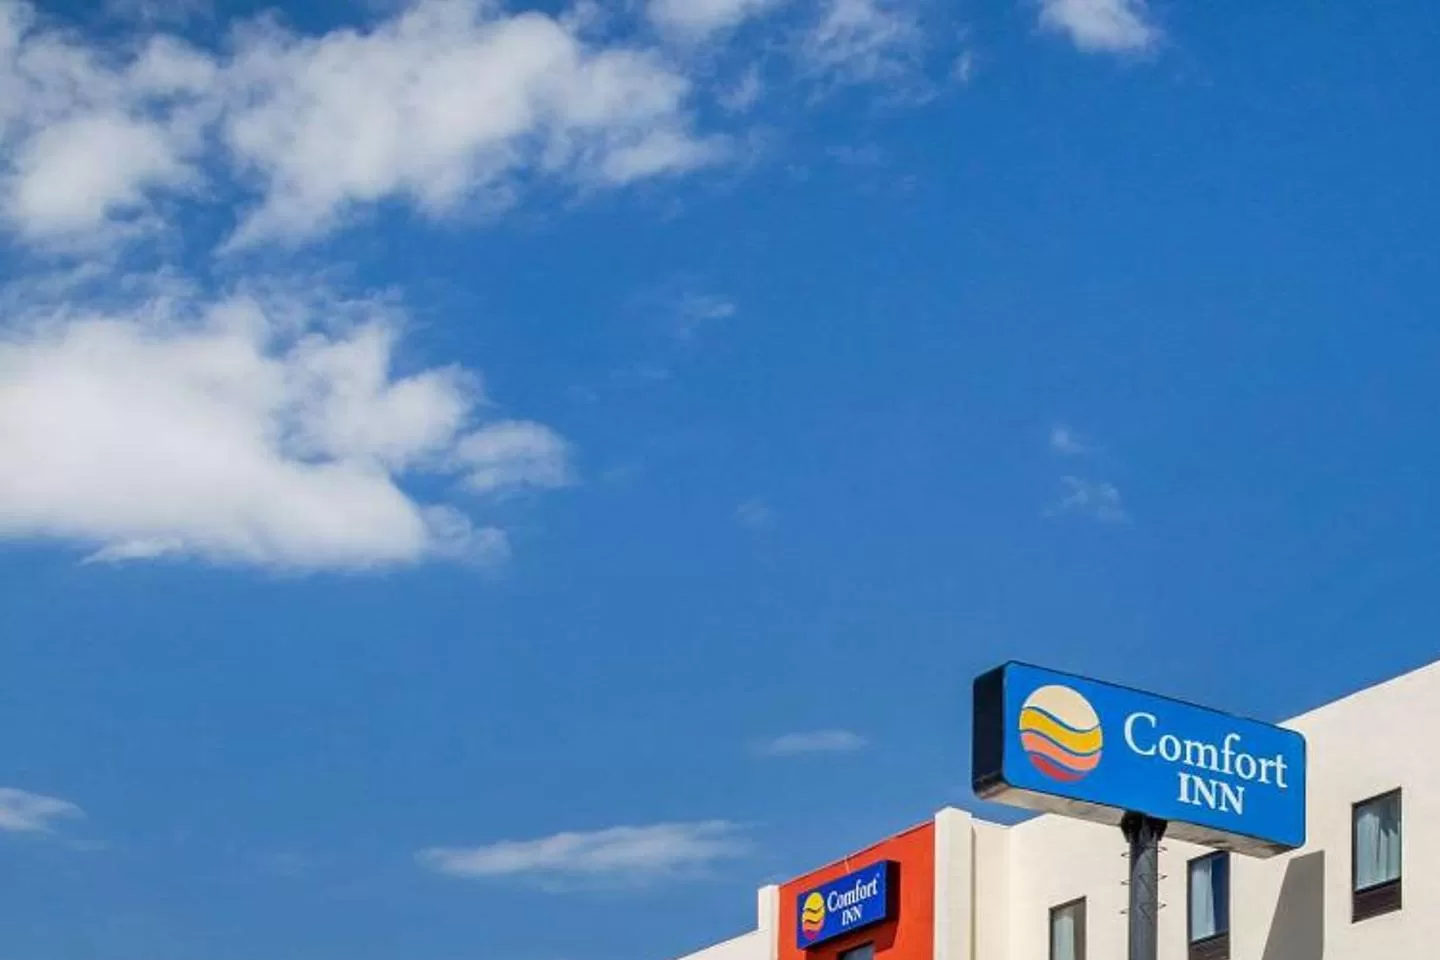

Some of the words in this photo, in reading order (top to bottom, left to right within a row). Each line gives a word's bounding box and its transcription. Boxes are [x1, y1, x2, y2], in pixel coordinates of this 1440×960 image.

[1124, 712, 1288, 788] Comfort
[1177, 772, 1245, 815] INN
[827, 878, 878, 912] Comfort
[842, 904, 863, 926] INN
